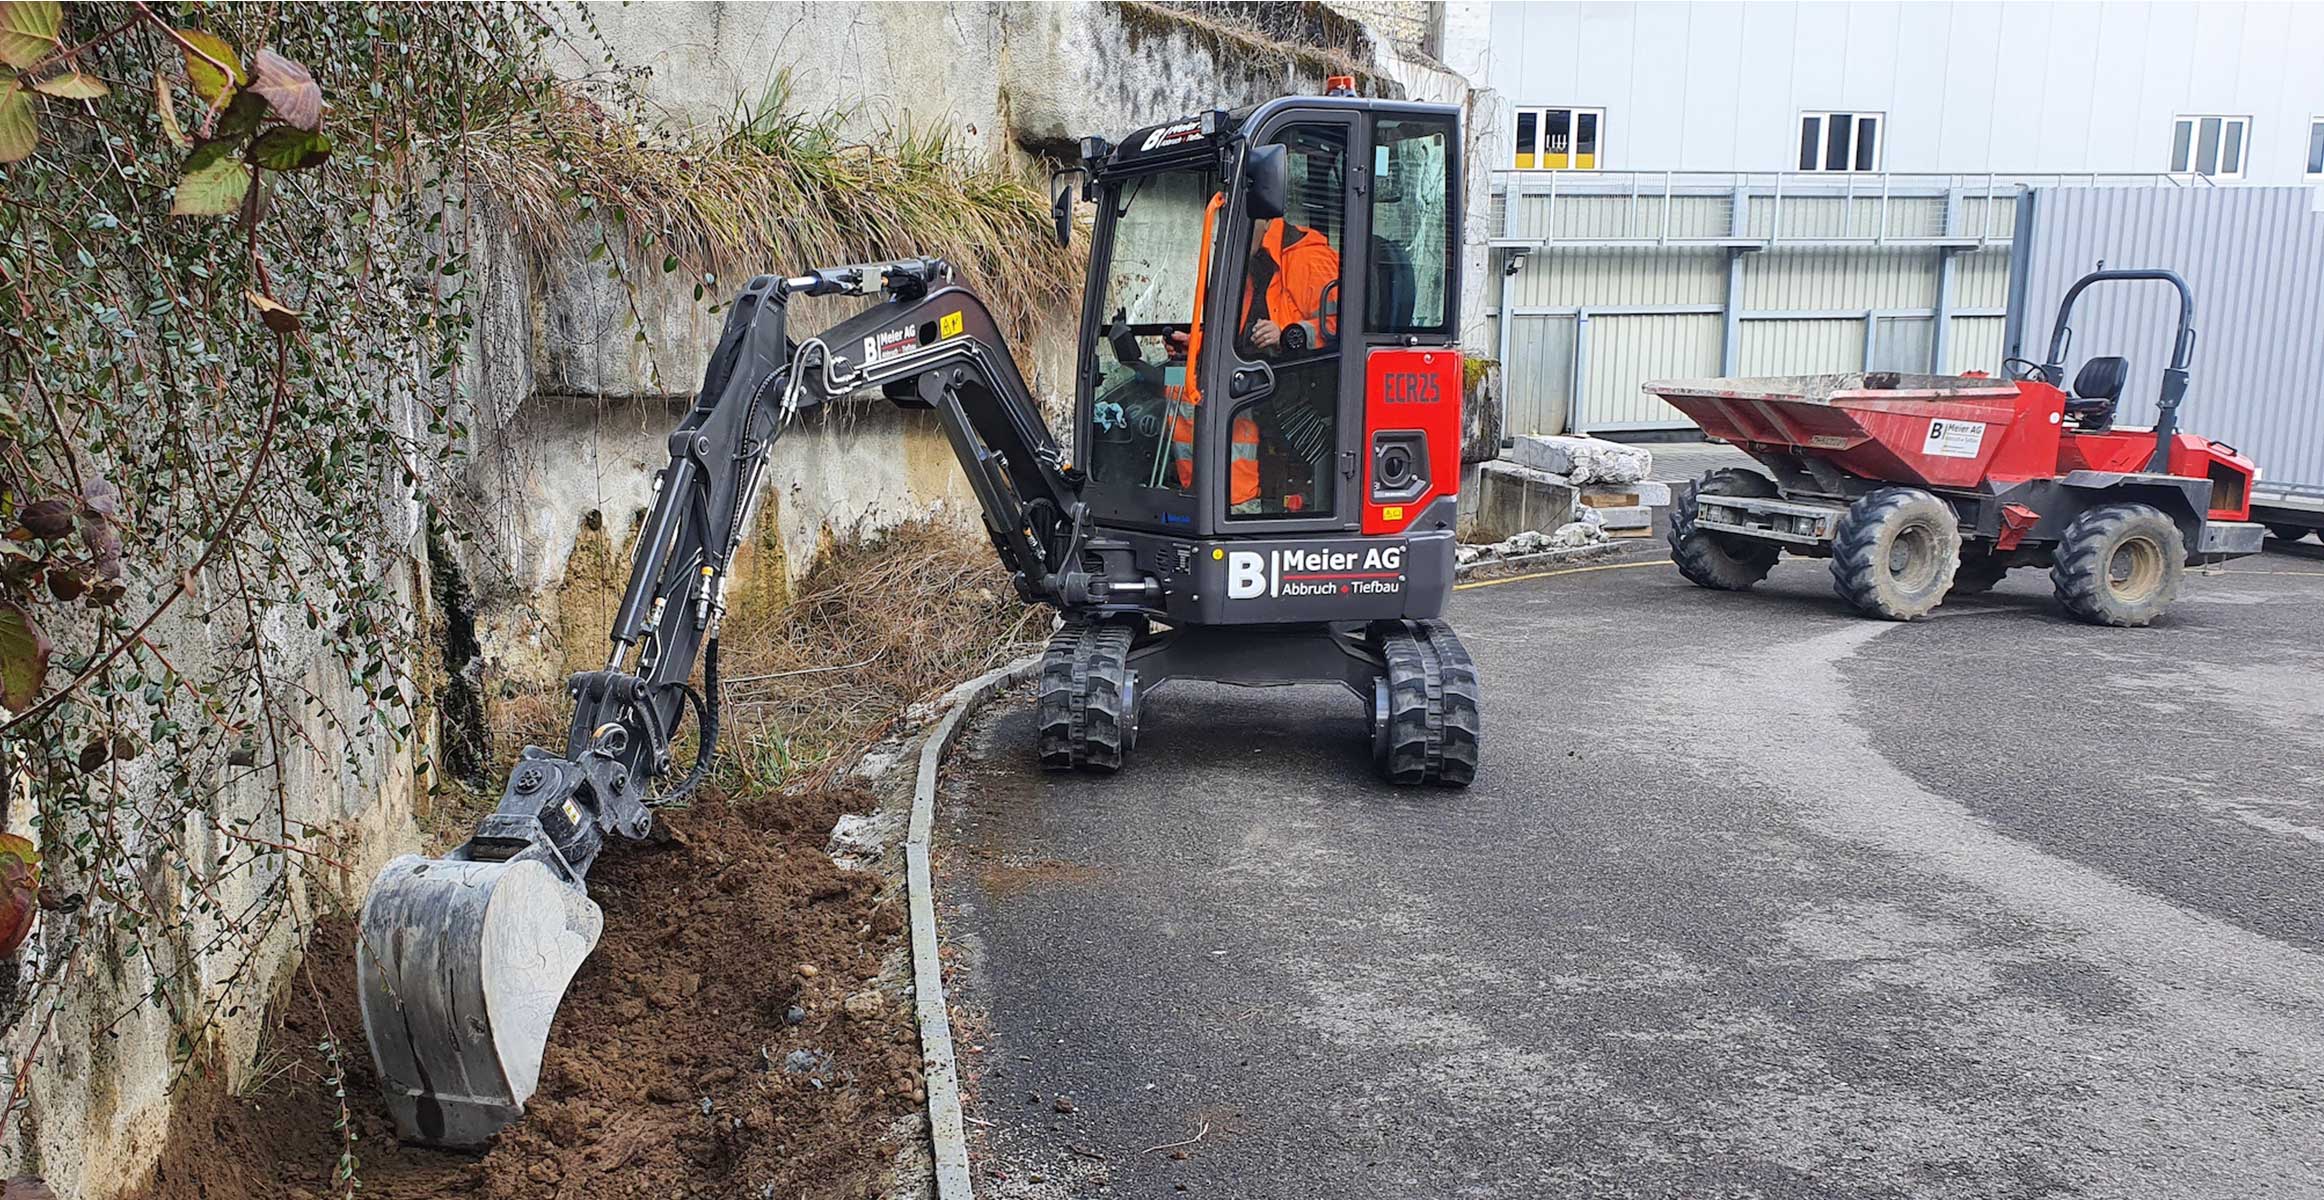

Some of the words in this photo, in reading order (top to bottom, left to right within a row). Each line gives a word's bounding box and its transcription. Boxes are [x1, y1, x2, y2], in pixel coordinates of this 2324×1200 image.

[880, 330, 904, 346] Meier
[904, 324, 916, 339] AG
[1384, 373, 1441, 403] ECR25
[1930, 422, 1943, 439] B
[1948, 423, 1969, 432] Meier
[1970, 425, 1983, 434] AG
[1228, 551, 1266, 599] B
[1283, 549, 1358, 571] Meier
[1363, 547, 1400, 570] AG
[1282, 582, 1337, 596] Abbruch
[1351, 580, 1399, 594] Tiefbau
